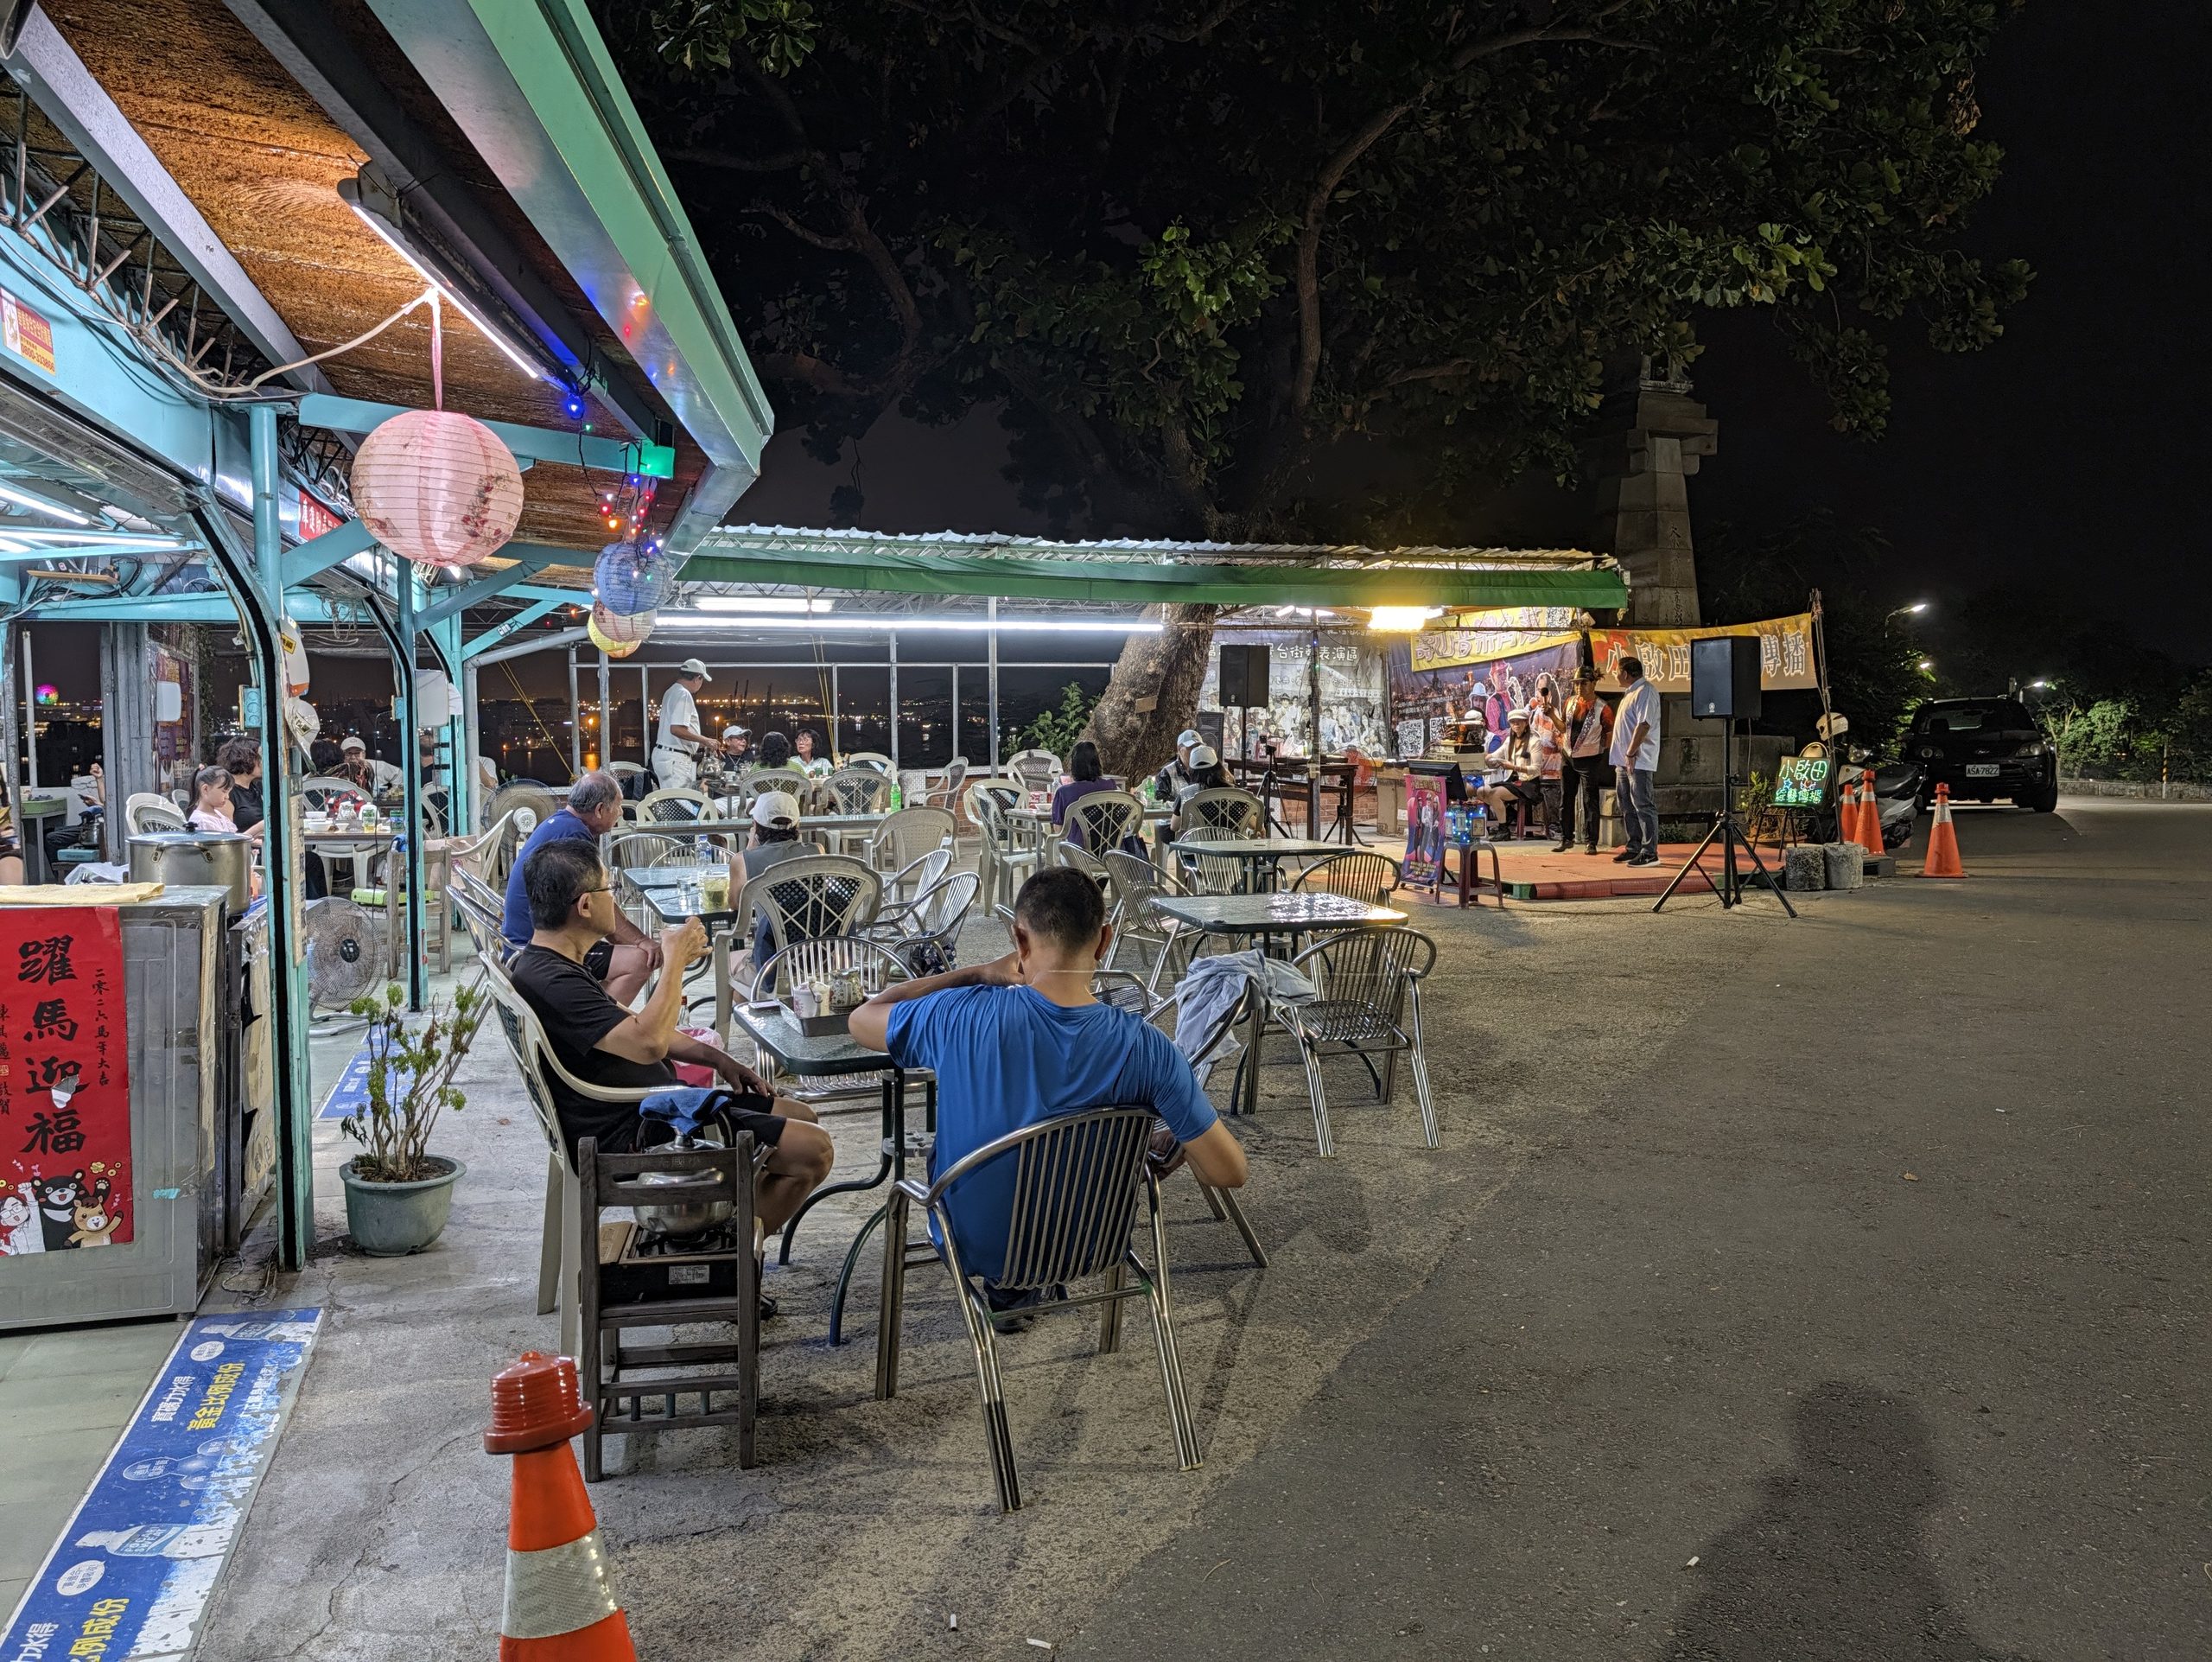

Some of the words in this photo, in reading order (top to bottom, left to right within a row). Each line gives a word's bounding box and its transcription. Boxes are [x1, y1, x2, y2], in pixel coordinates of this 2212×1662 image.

[1967, 767, 1999, 775] ASA-7822
[17, 934, 89, 1156] 躍馬迎福
[92, 968, 111, 1086] 二零二六馬年大吉
[151, 1375, 196, 1423] 寶礦力水得
[187, 1362, 246, 1431] 黃金比例成份
